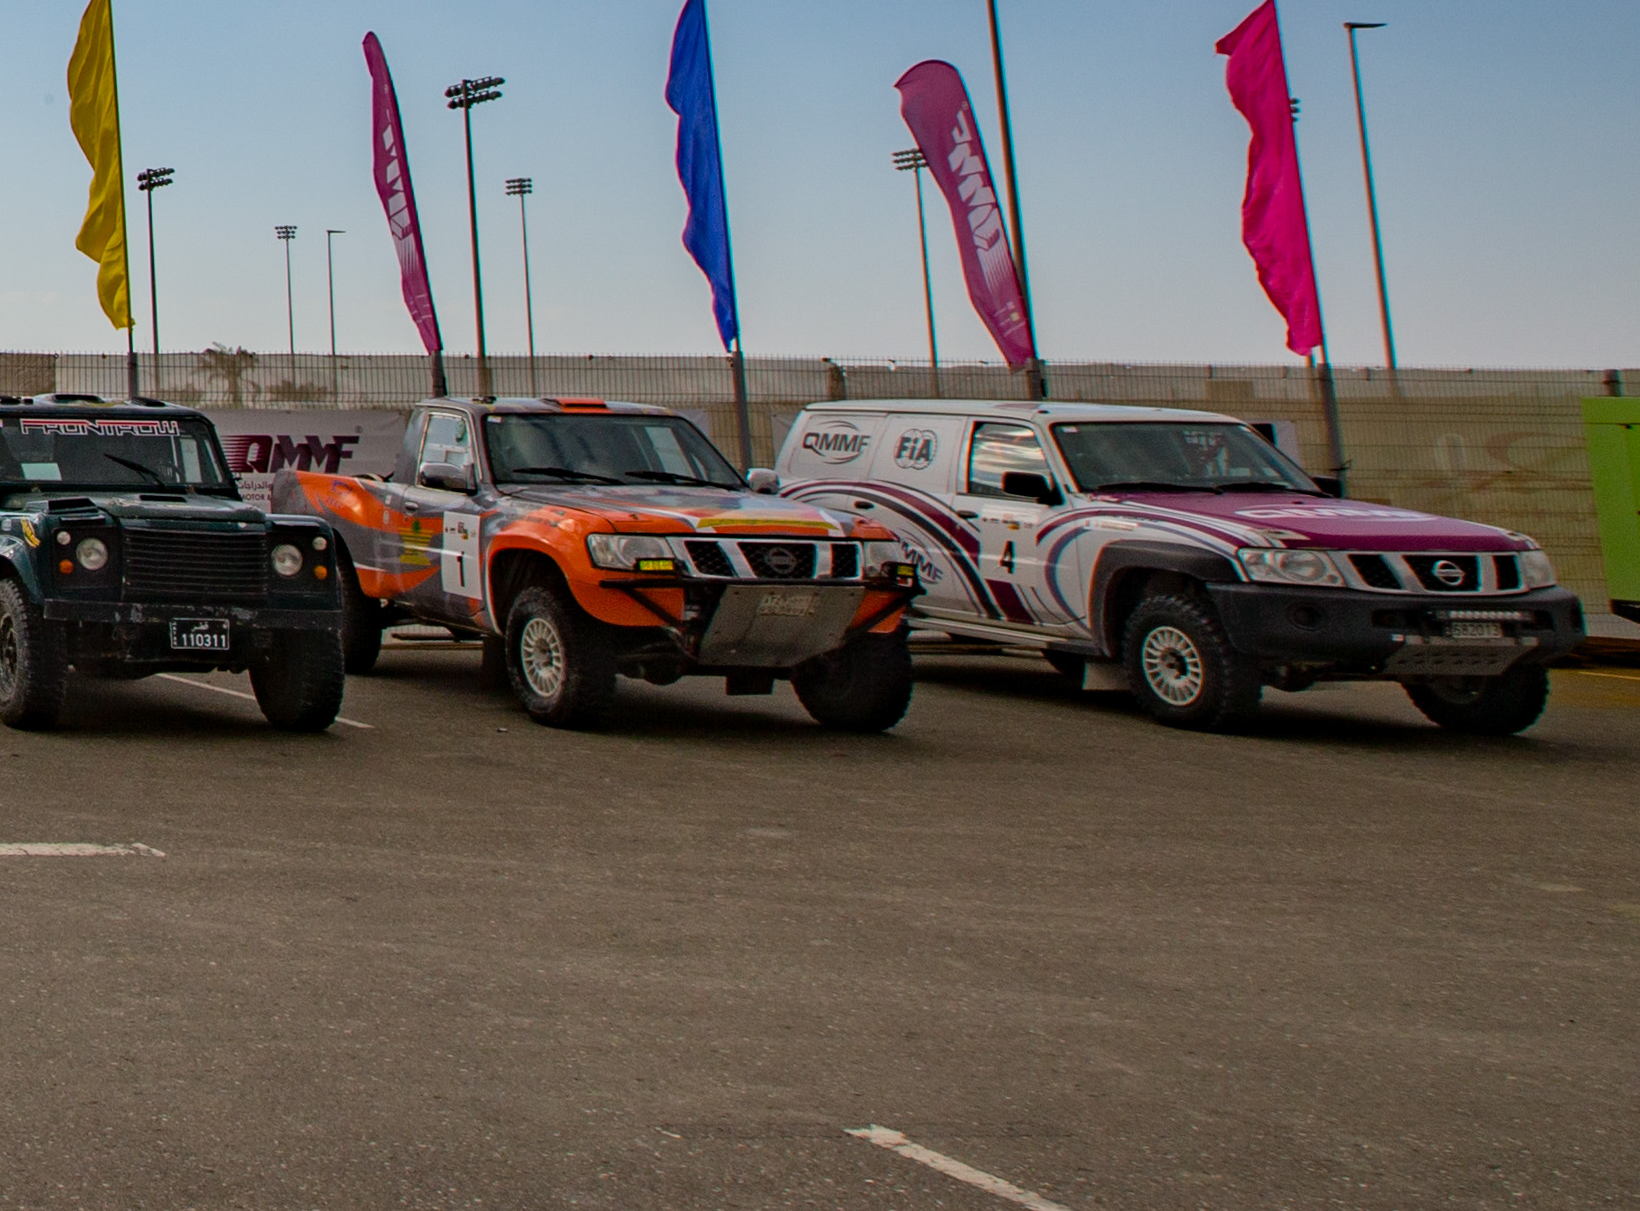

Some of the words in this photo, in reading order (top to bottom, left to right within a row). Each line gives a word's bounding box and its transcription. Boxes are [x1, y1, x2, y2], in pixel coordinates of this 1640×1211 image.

[21, 418, 181, 437] FRONTROW
[802, 432, 871, 458] QMMF
[220, 435, 361, 474] QMMF
[456, 550, 466, 588] 1
[899, 540, 944, 581] MMF
[998, 540, 1015, 575] 4
[182, 633, 226, 648] 110311
